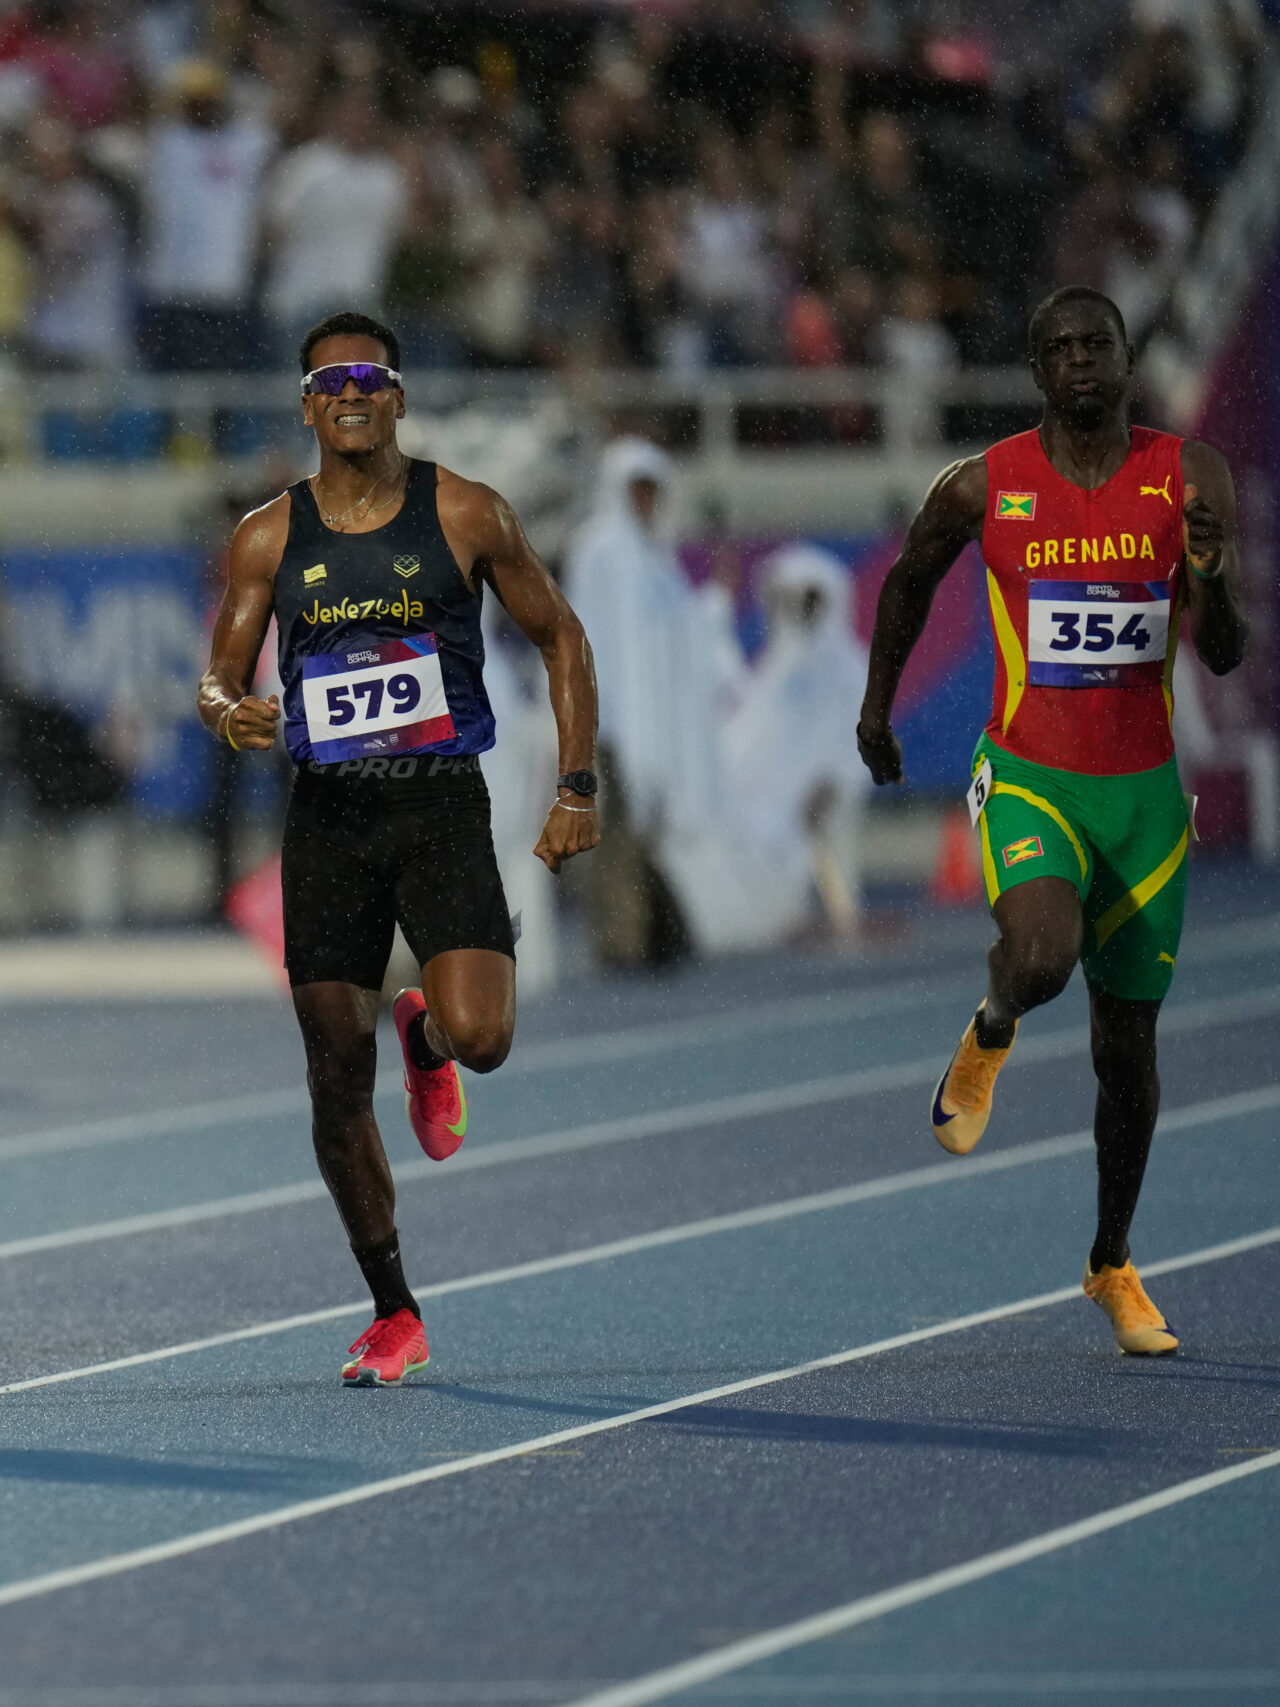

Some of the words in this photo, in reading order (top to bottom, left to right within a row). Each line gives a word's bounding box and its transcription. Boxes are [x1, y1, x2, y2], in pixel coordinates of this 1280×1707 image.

[1026, 533, 1155, 568] GRENADA
[1049, 612, 1150, 652] 354
[326, 673, 421, 726] 579
[336, 757, 418, 778] PRO
[975, 776, 985, 808] 5
